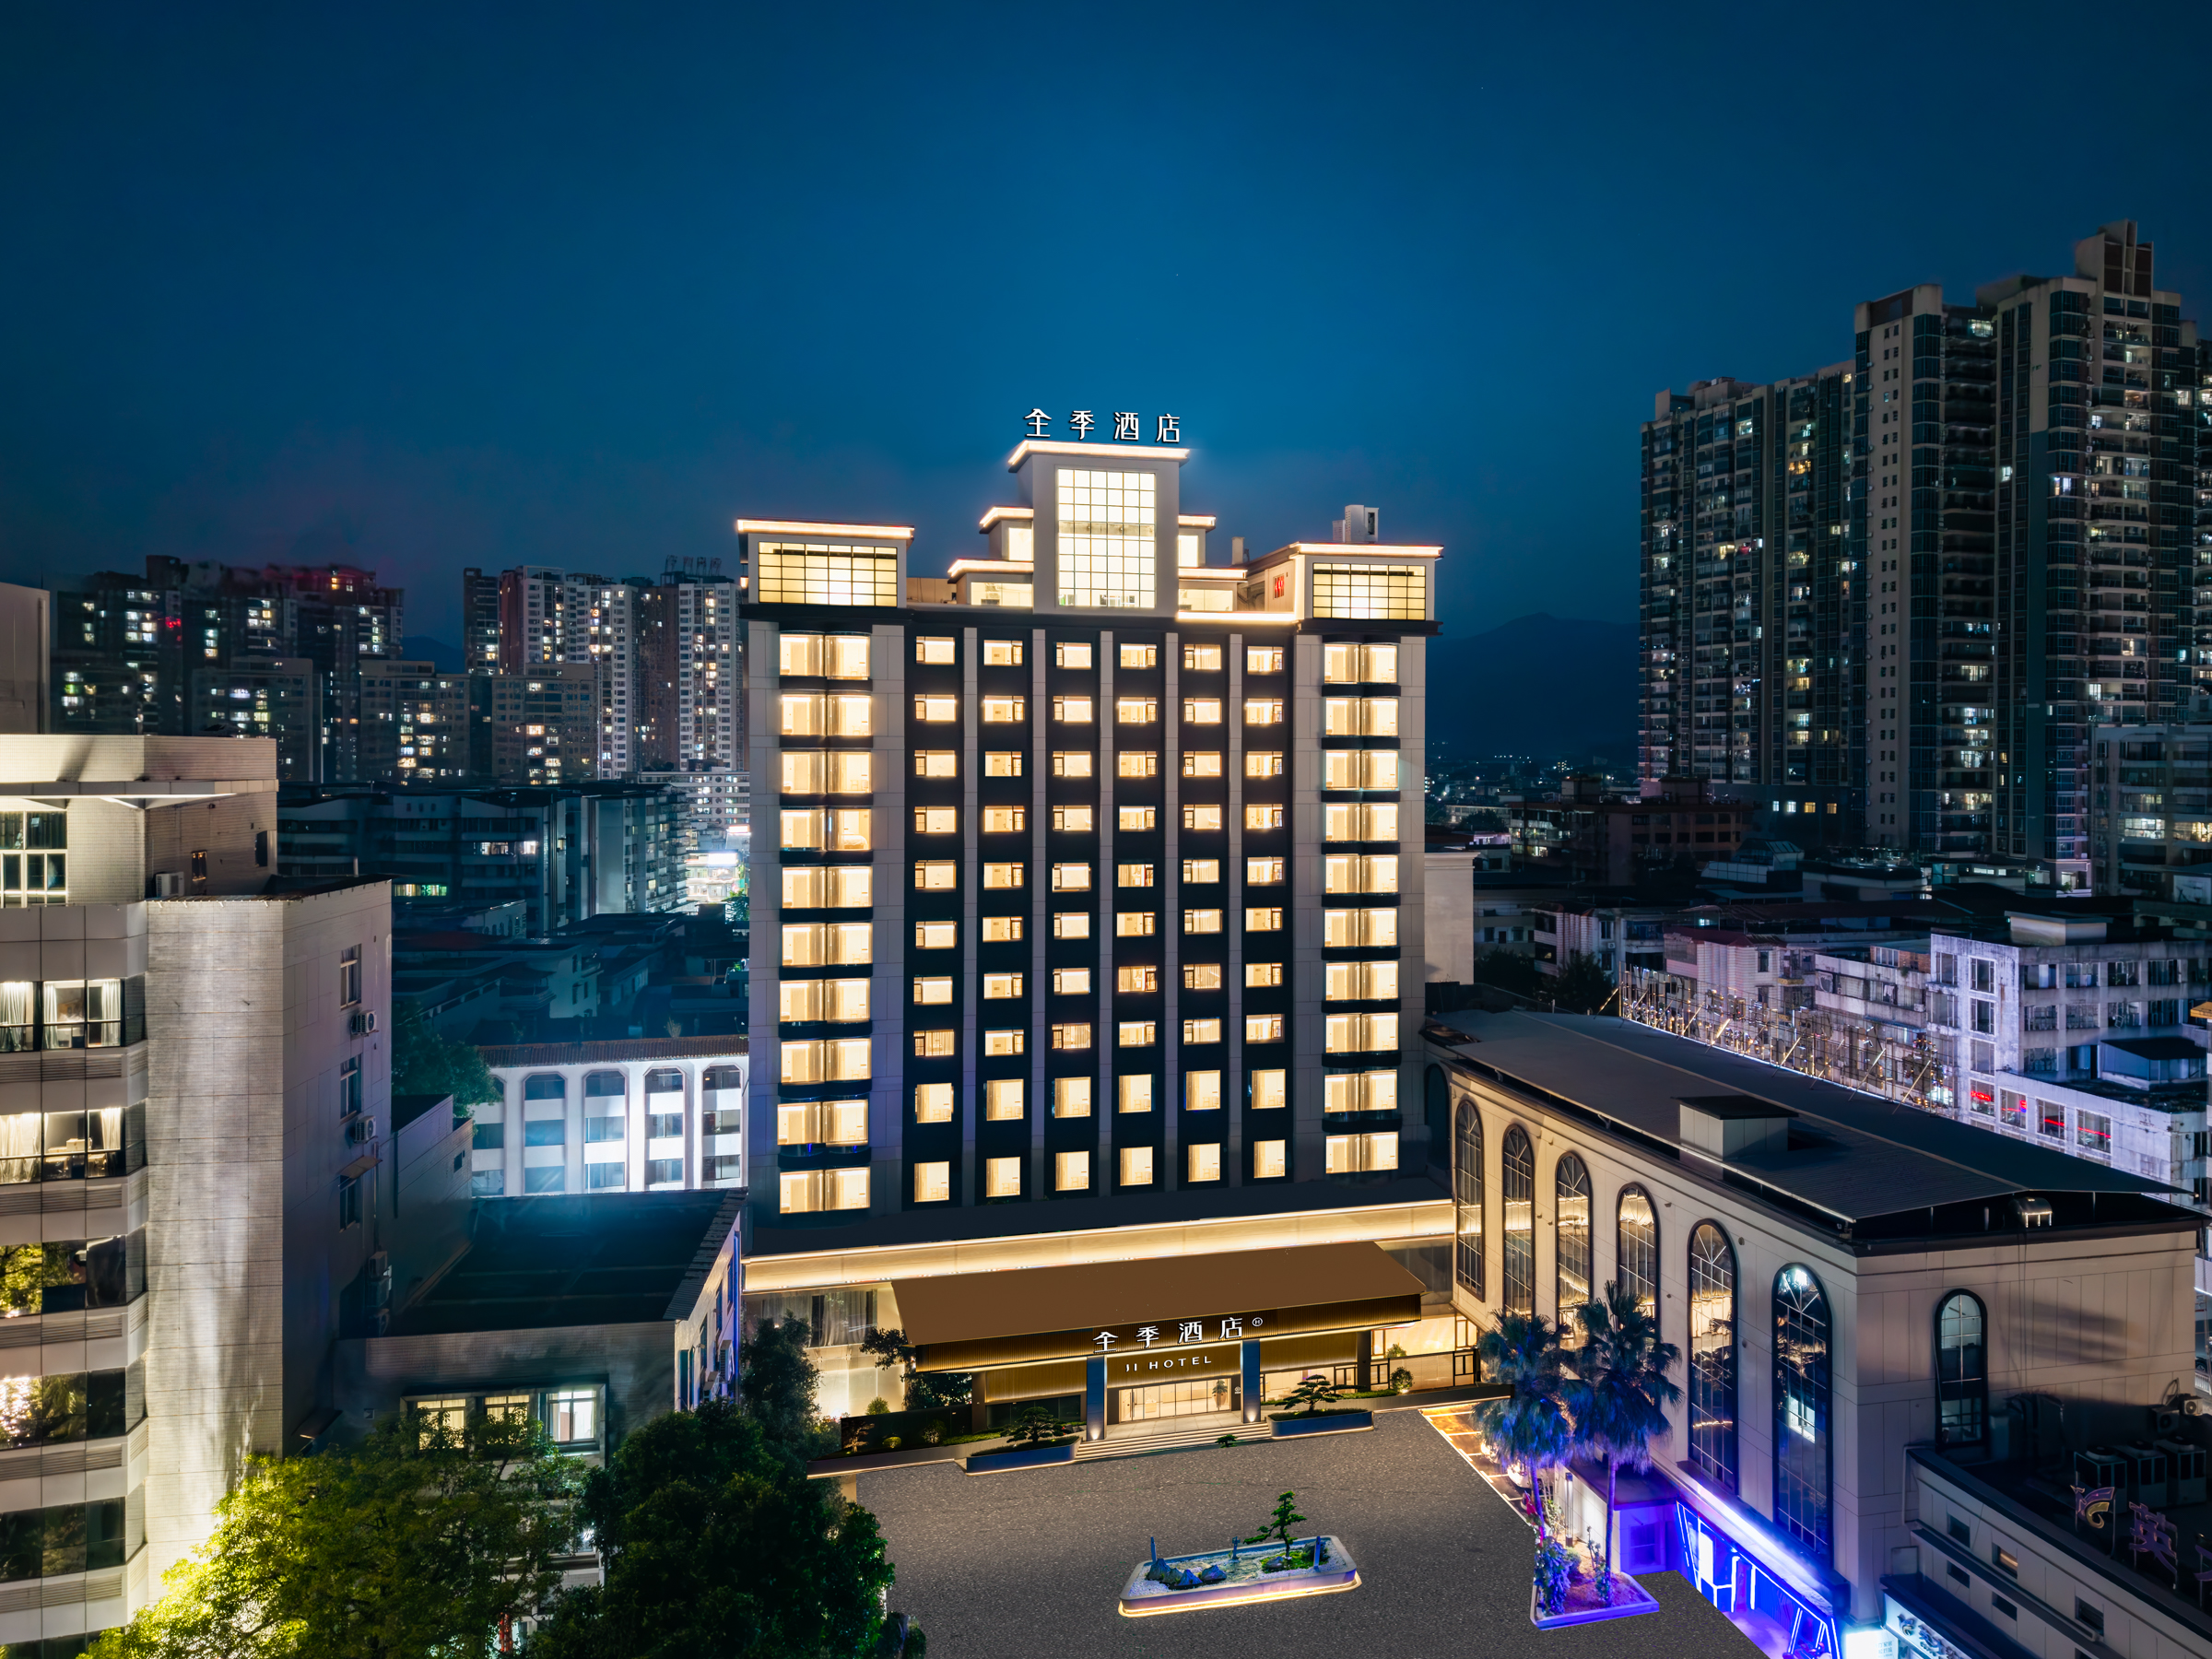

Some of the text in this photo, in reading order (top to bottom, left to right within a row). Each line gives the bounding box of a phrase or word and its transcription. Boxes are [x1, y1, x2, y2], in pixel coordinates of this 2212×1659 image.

[1024, 408, 1181, 443] 全季酒店
[1092, 1317, 1242, 1353] 全季酒店
[1148, 1356, 1212, 1371] HOTEL
